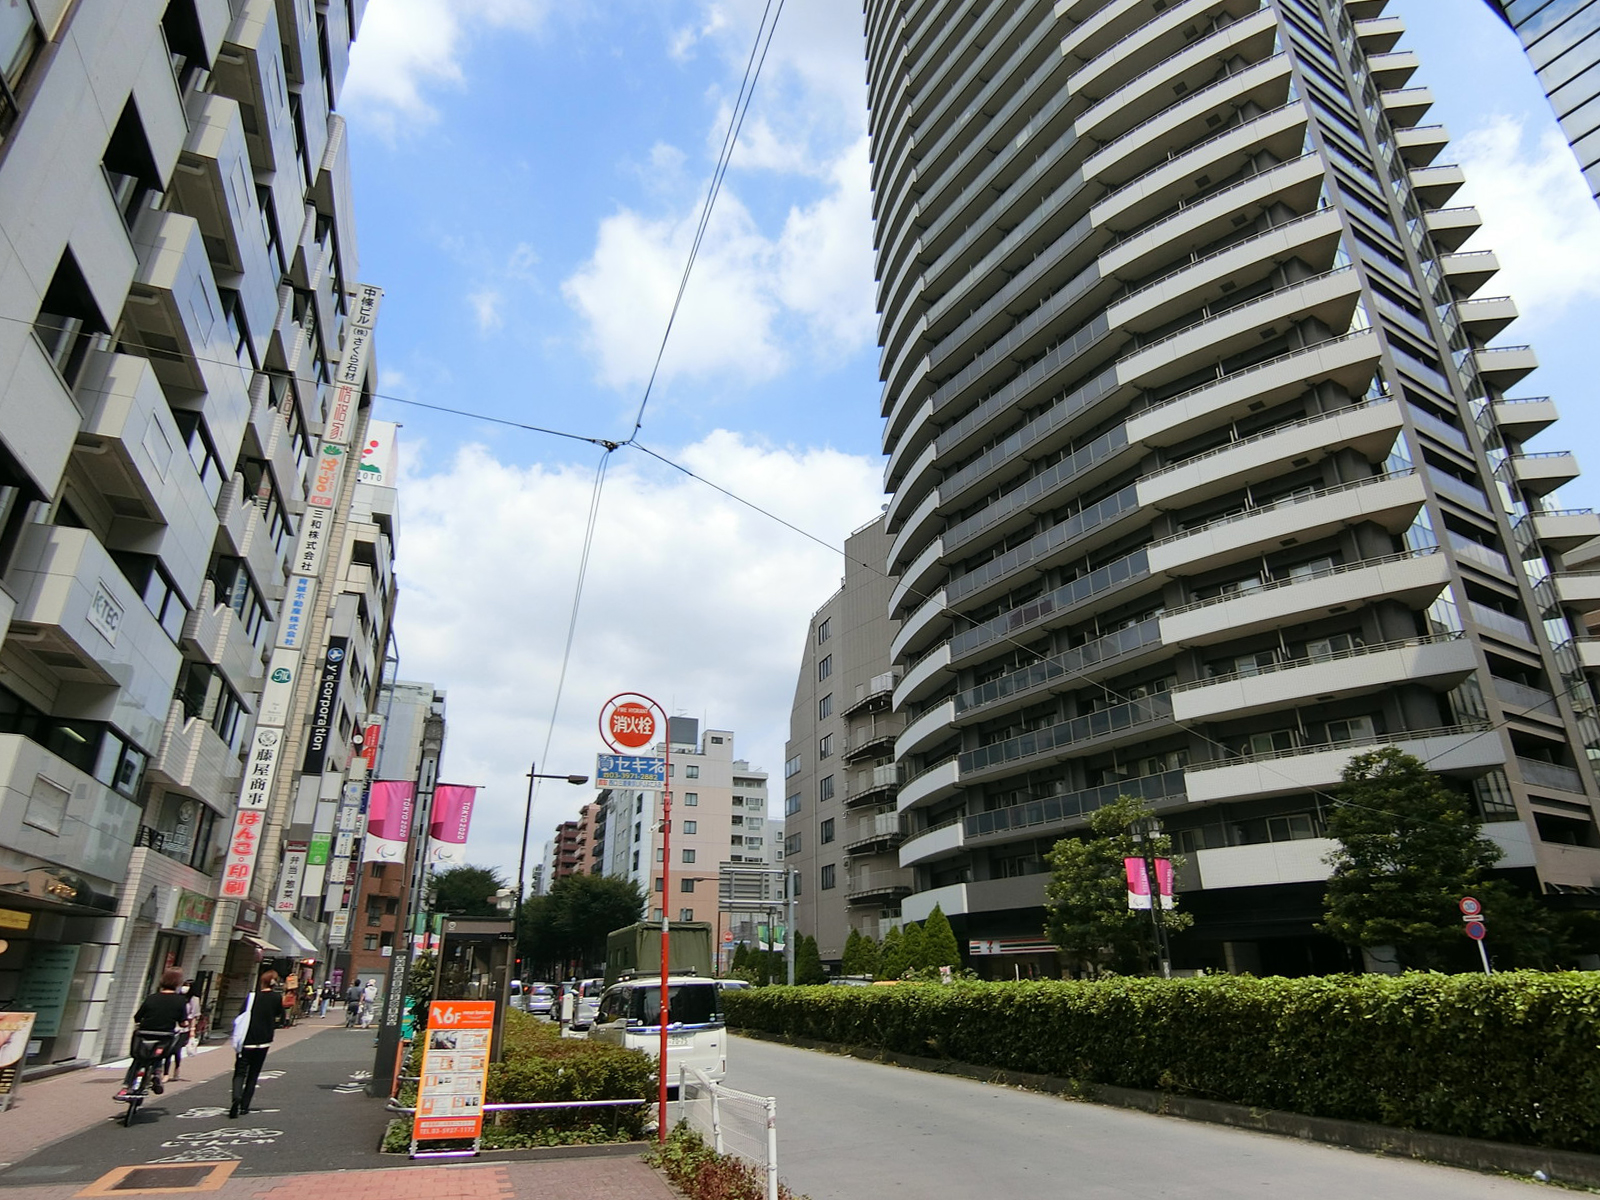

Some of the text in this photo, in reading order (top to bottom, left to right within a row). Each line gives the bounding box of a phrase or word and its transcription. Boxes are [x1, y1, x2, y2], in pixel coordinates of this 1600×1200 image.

[301, 509, 323, 572] 三和株式会社
[613, 715, 653, 734] 消火栓
[246, 748, 274, 805] 藤屋商事
[615, 757, 665, 773] セキネ
[399, 798, 411, 838] TOKYO 2020
[457, 802, 471, 840] TOKYO 2020
[278, 901, 294, 909] 24h
[443, 1006, 462, 1024] 6F
